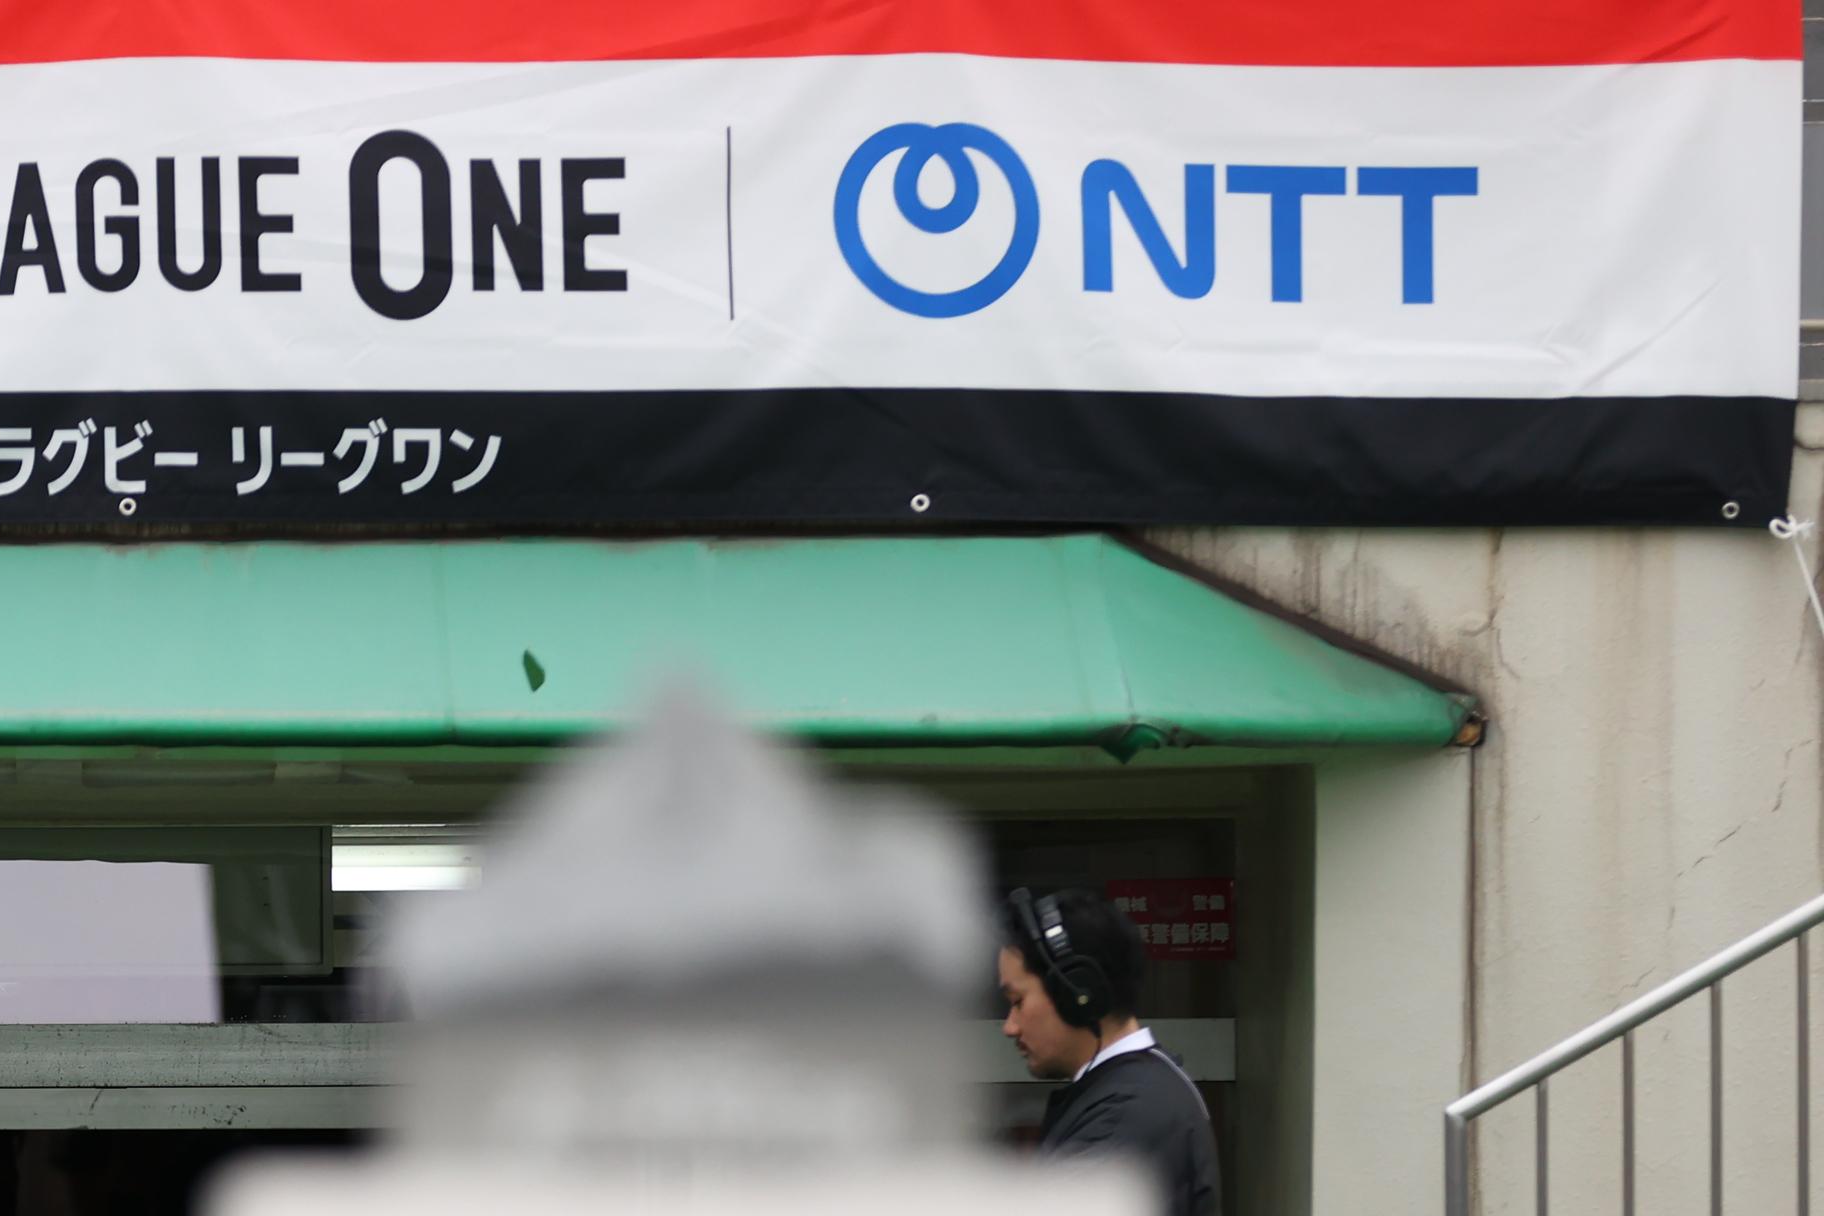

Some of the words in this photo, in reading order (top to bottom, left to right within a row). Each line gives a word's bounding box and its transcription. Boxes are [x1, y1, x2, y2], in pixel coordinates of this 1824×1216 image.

[349, 130, 628, 321] ONE
[1080, 158, 1480, 305] NTT
[231, 417, 501, 495] リーグワン
